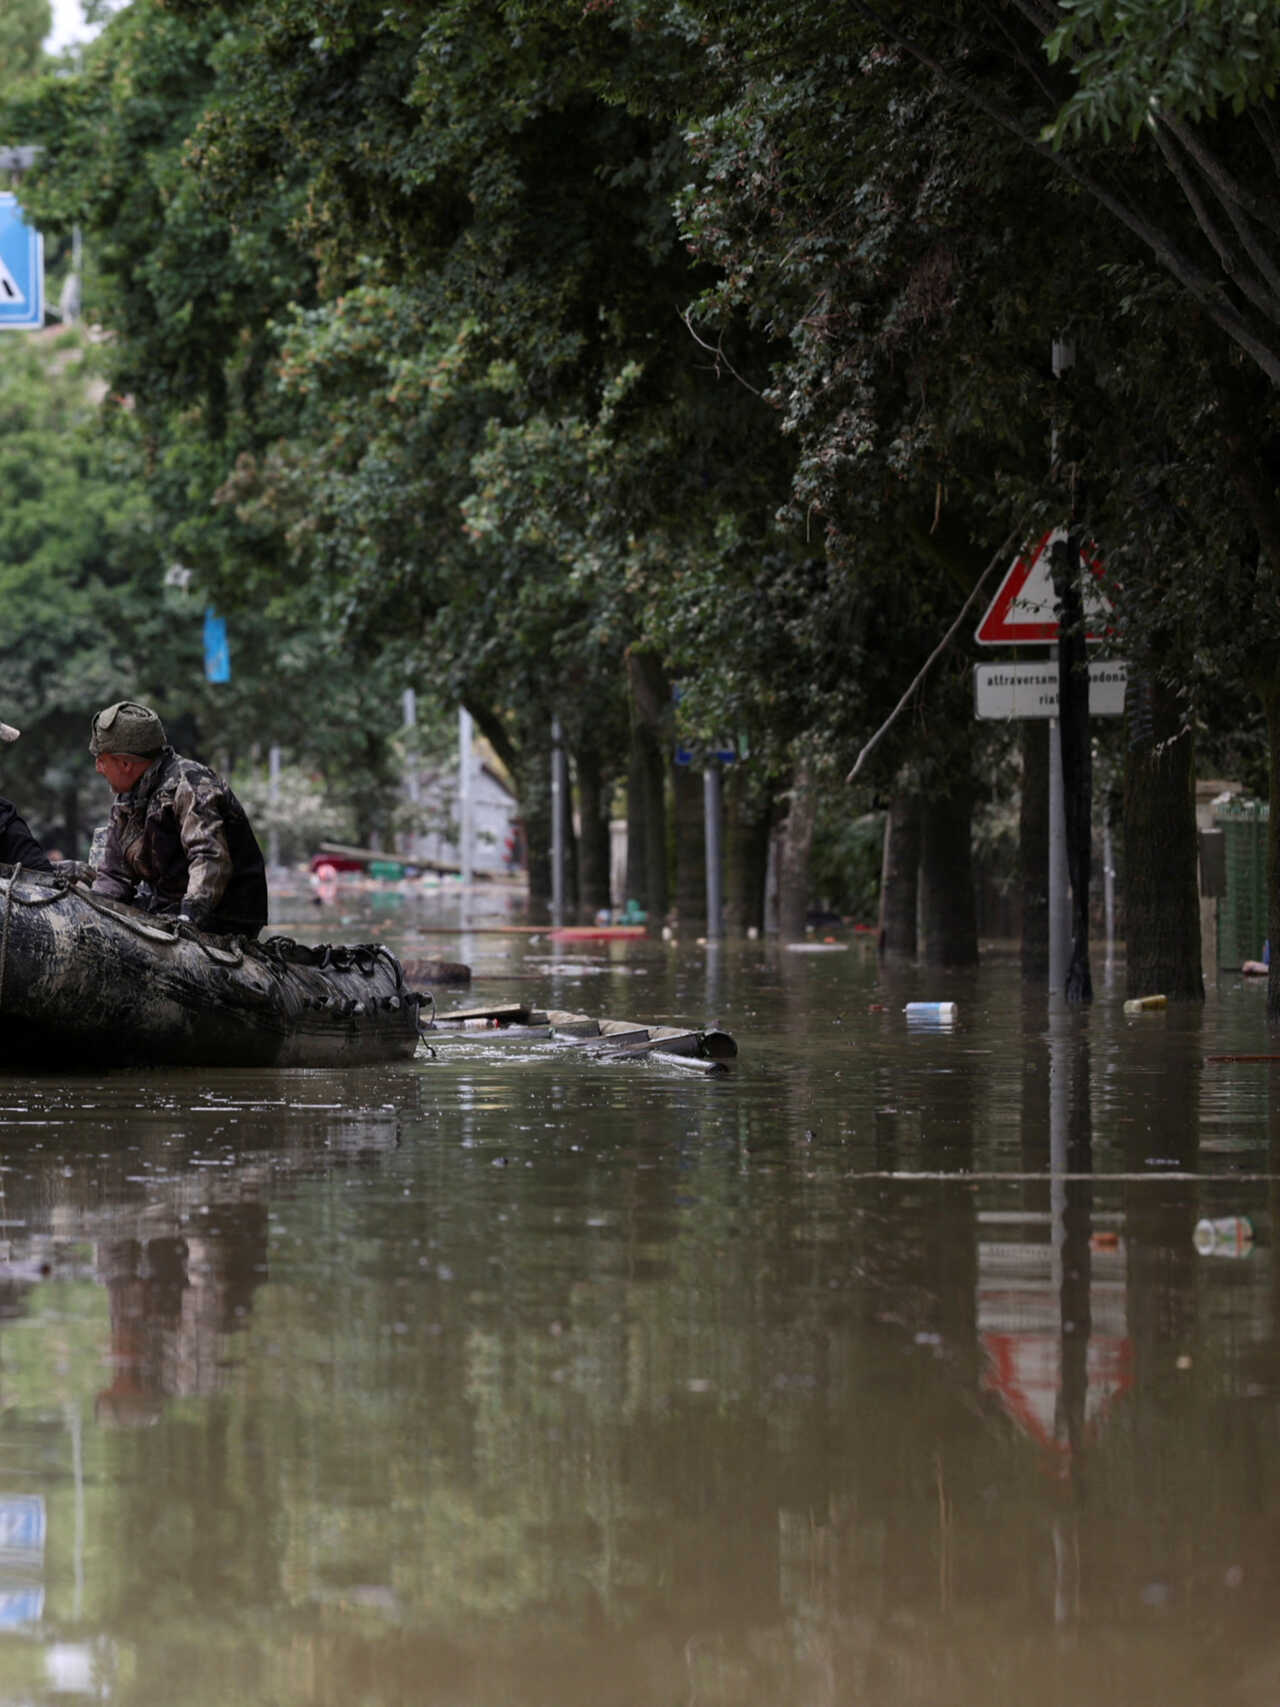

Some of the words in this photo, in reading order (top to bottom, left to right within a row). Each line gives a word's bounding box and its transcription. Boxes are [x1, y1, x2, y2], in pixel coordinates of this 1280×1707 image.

[987, 673, 1058, 687] attraversam
[1087, 670, 1126, 684] edona
[1039, 693, 1059, 706] rial
